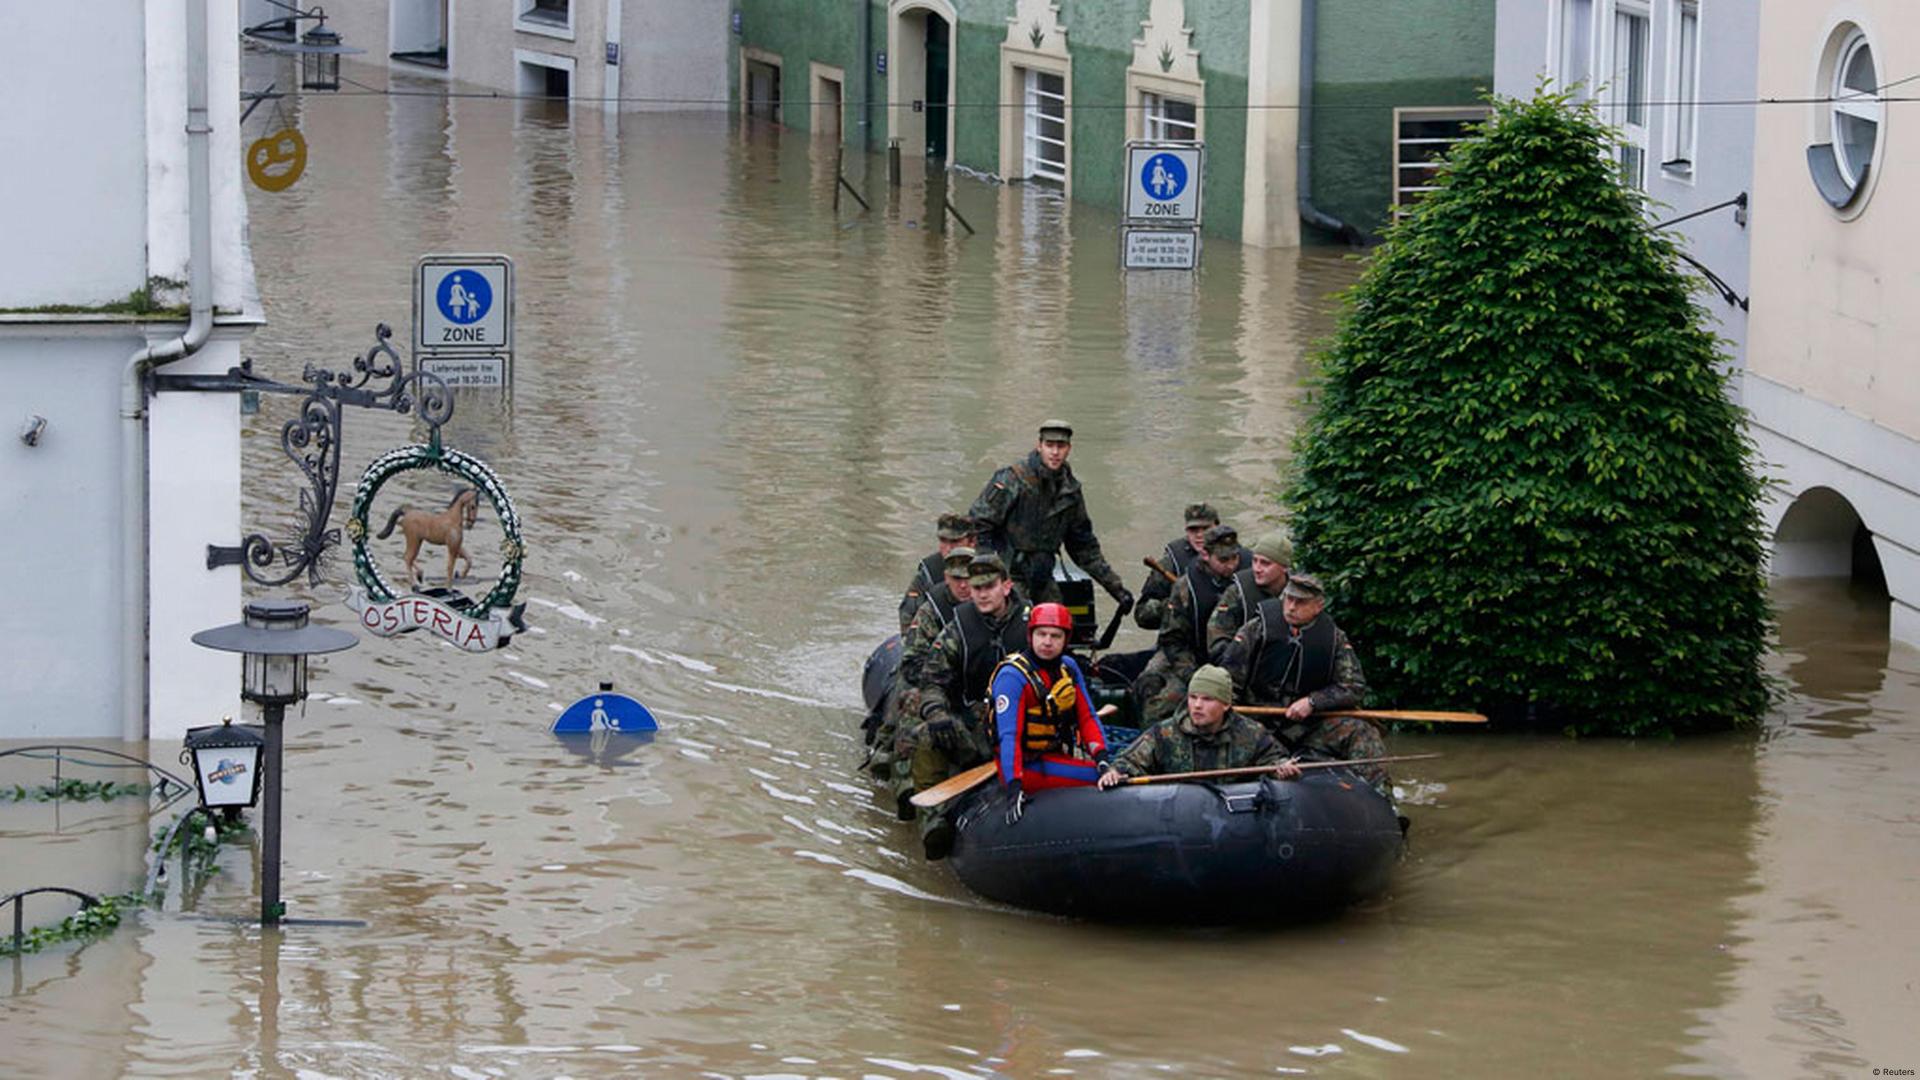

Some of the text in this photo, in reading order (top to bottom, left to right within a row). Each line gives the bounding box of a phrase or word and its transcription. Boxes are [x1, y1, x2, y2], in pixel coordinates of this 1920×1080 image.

[1144, 203, 1181, 216] ZONE
[442, 327, 486, 342] ZONE
[432, 363, 478, 373] Lieferverkehr
[364, 600, 486, 649] OSTERIA
